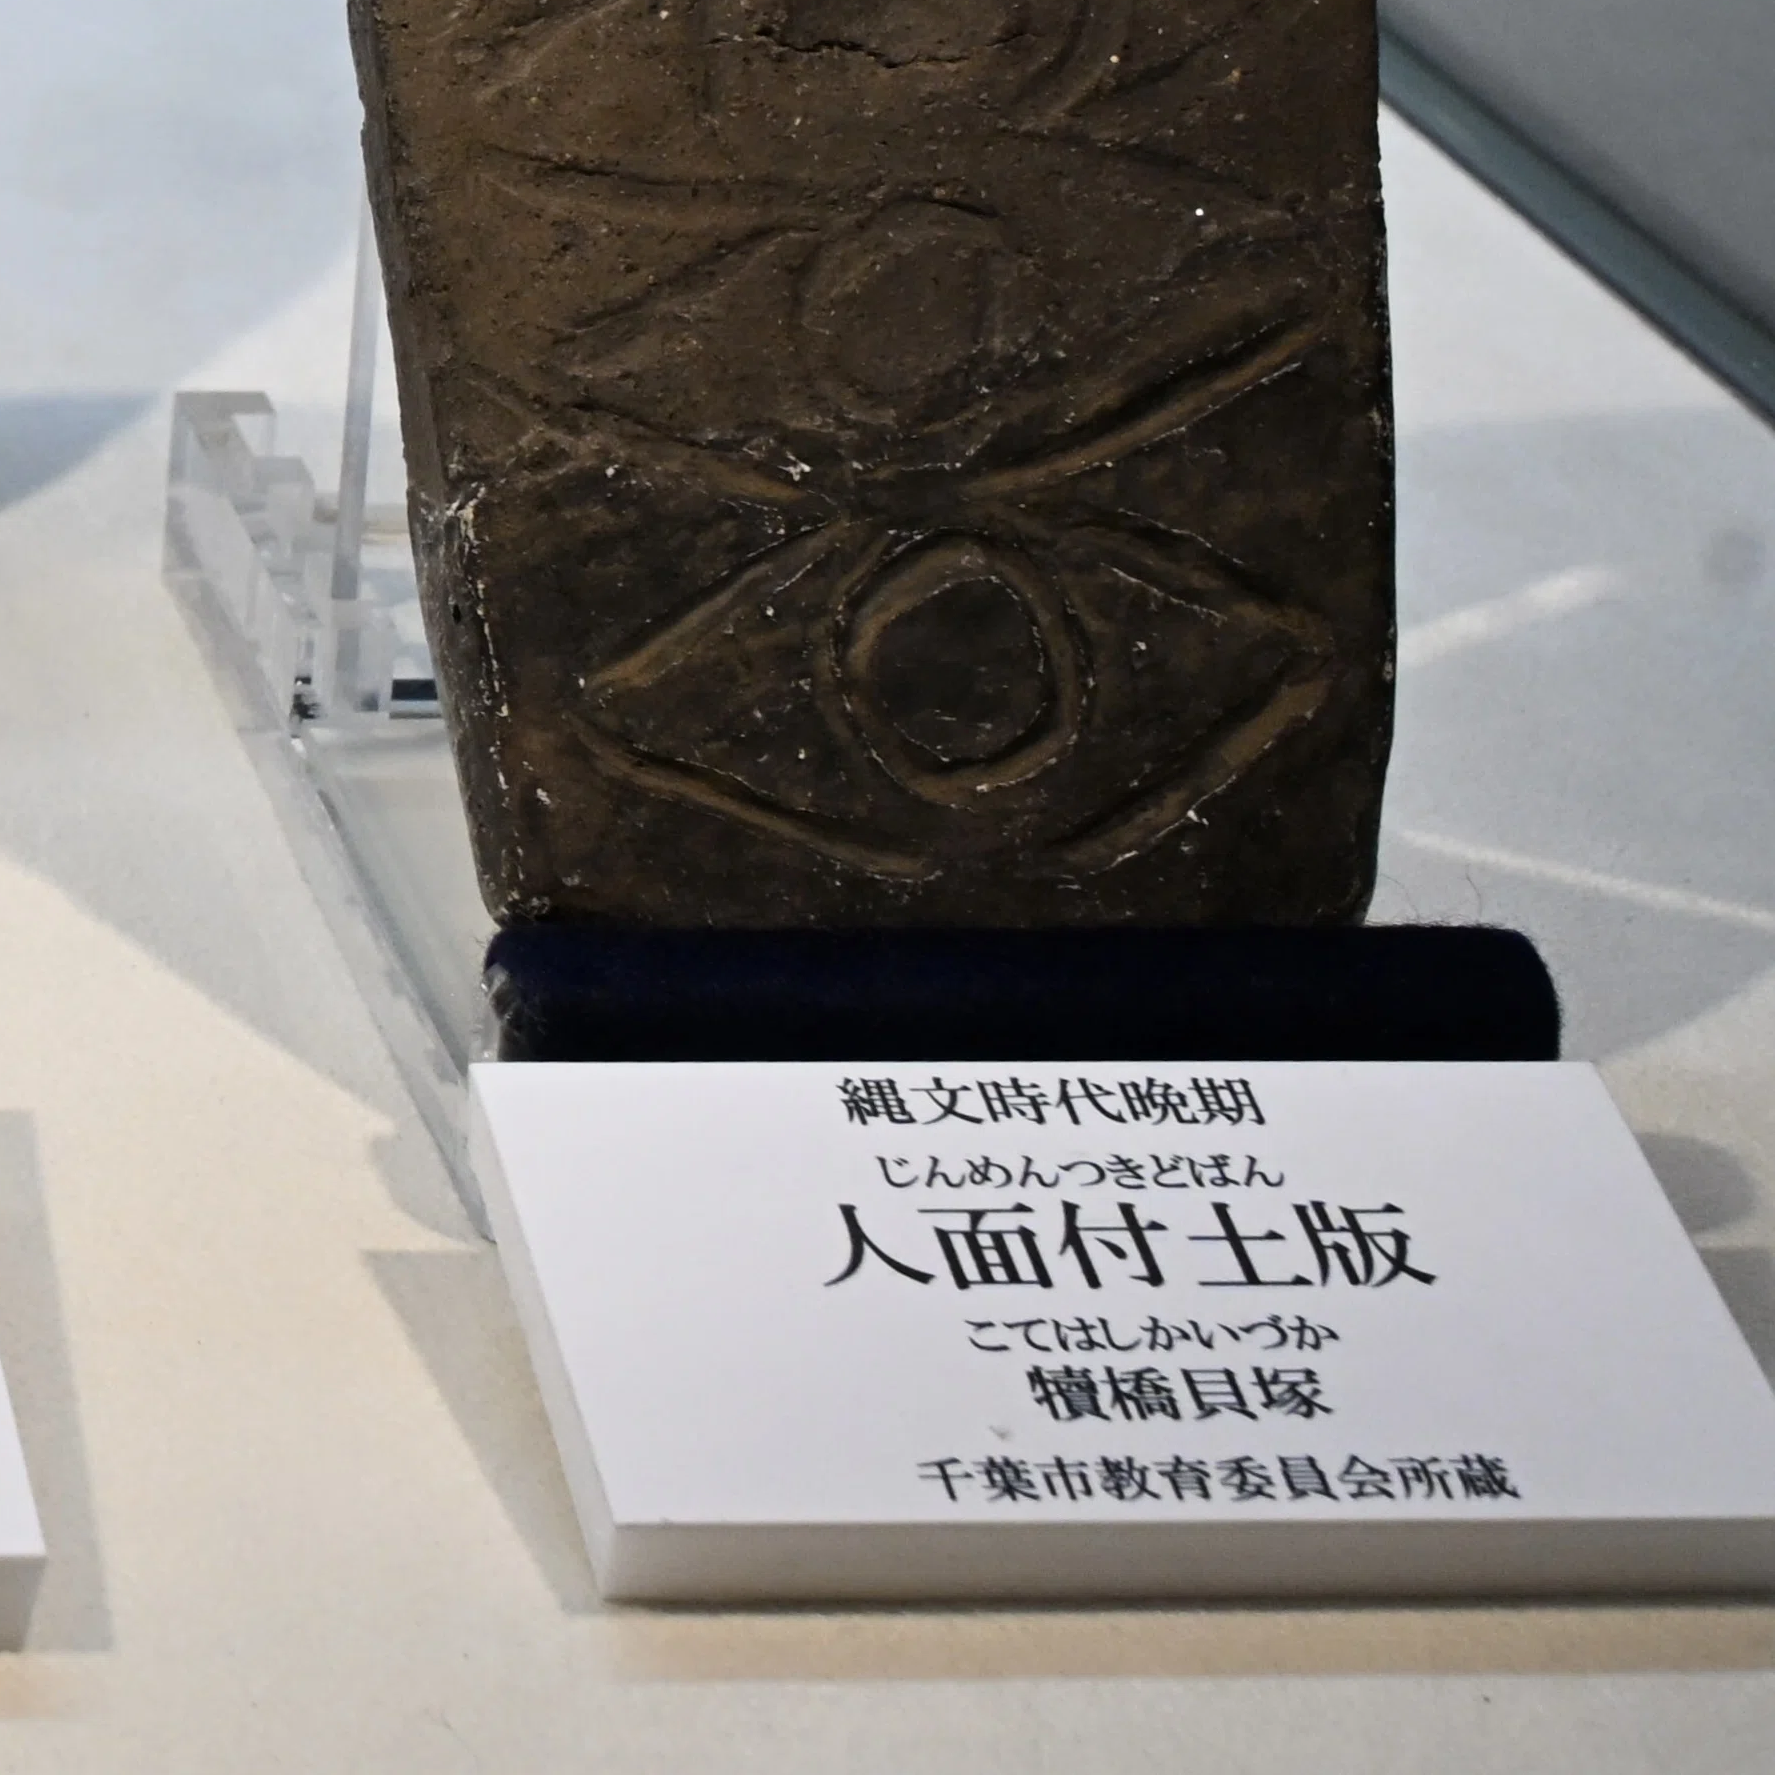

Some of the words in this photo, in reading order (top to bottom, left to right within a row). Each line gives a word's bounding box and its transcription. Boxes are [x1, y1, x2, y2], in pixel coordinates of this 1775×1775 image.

[835, 1075, 1267, 1127] 縄文時代晩期
[874, 1153, 1286, 1191] じんめんつきどばん
[823, 1199, 1439, 1292] 人面付土版
[963, 1313, 1341, 1354] こてはしかいづか
[1024, 1364, 1335, 1423] 犢橋貝塚
[916, 1452, 1522, 1503] 千葉市教育委員会所蔵
